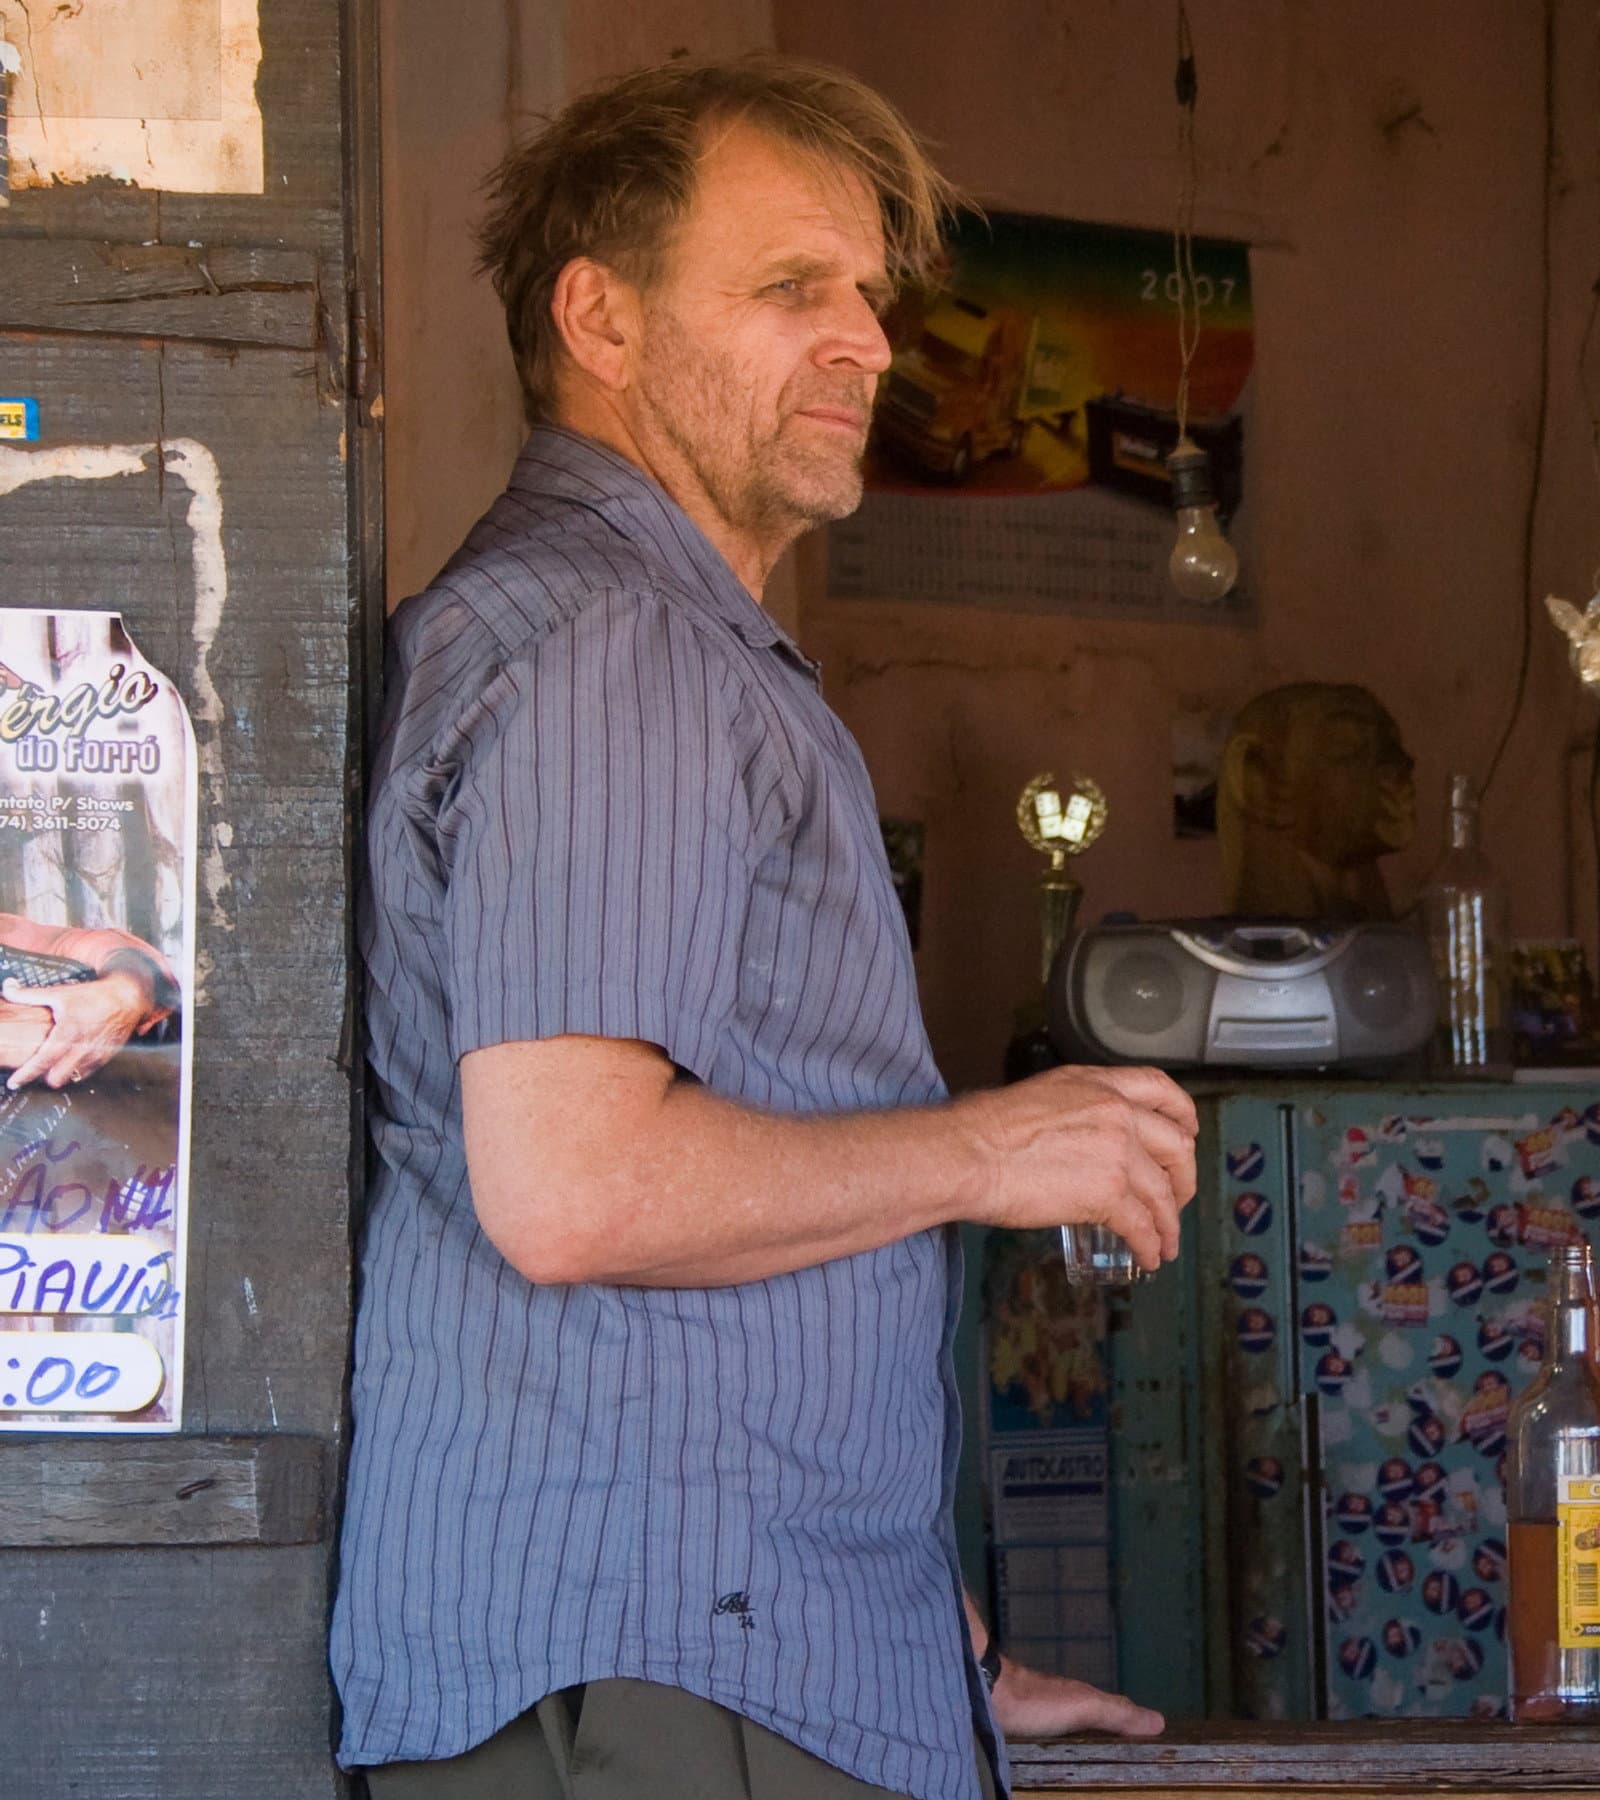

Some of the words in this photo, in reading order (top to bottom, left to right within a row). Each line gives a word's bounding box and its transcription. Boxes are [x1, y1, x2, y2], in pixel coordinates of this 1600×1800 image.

[1141, 269, 1235, 306] 2007
[16, 736, 57, 772] do
[76, 797, 135, 812] Shows
[32, 815, 121, 831] 3611-5074
